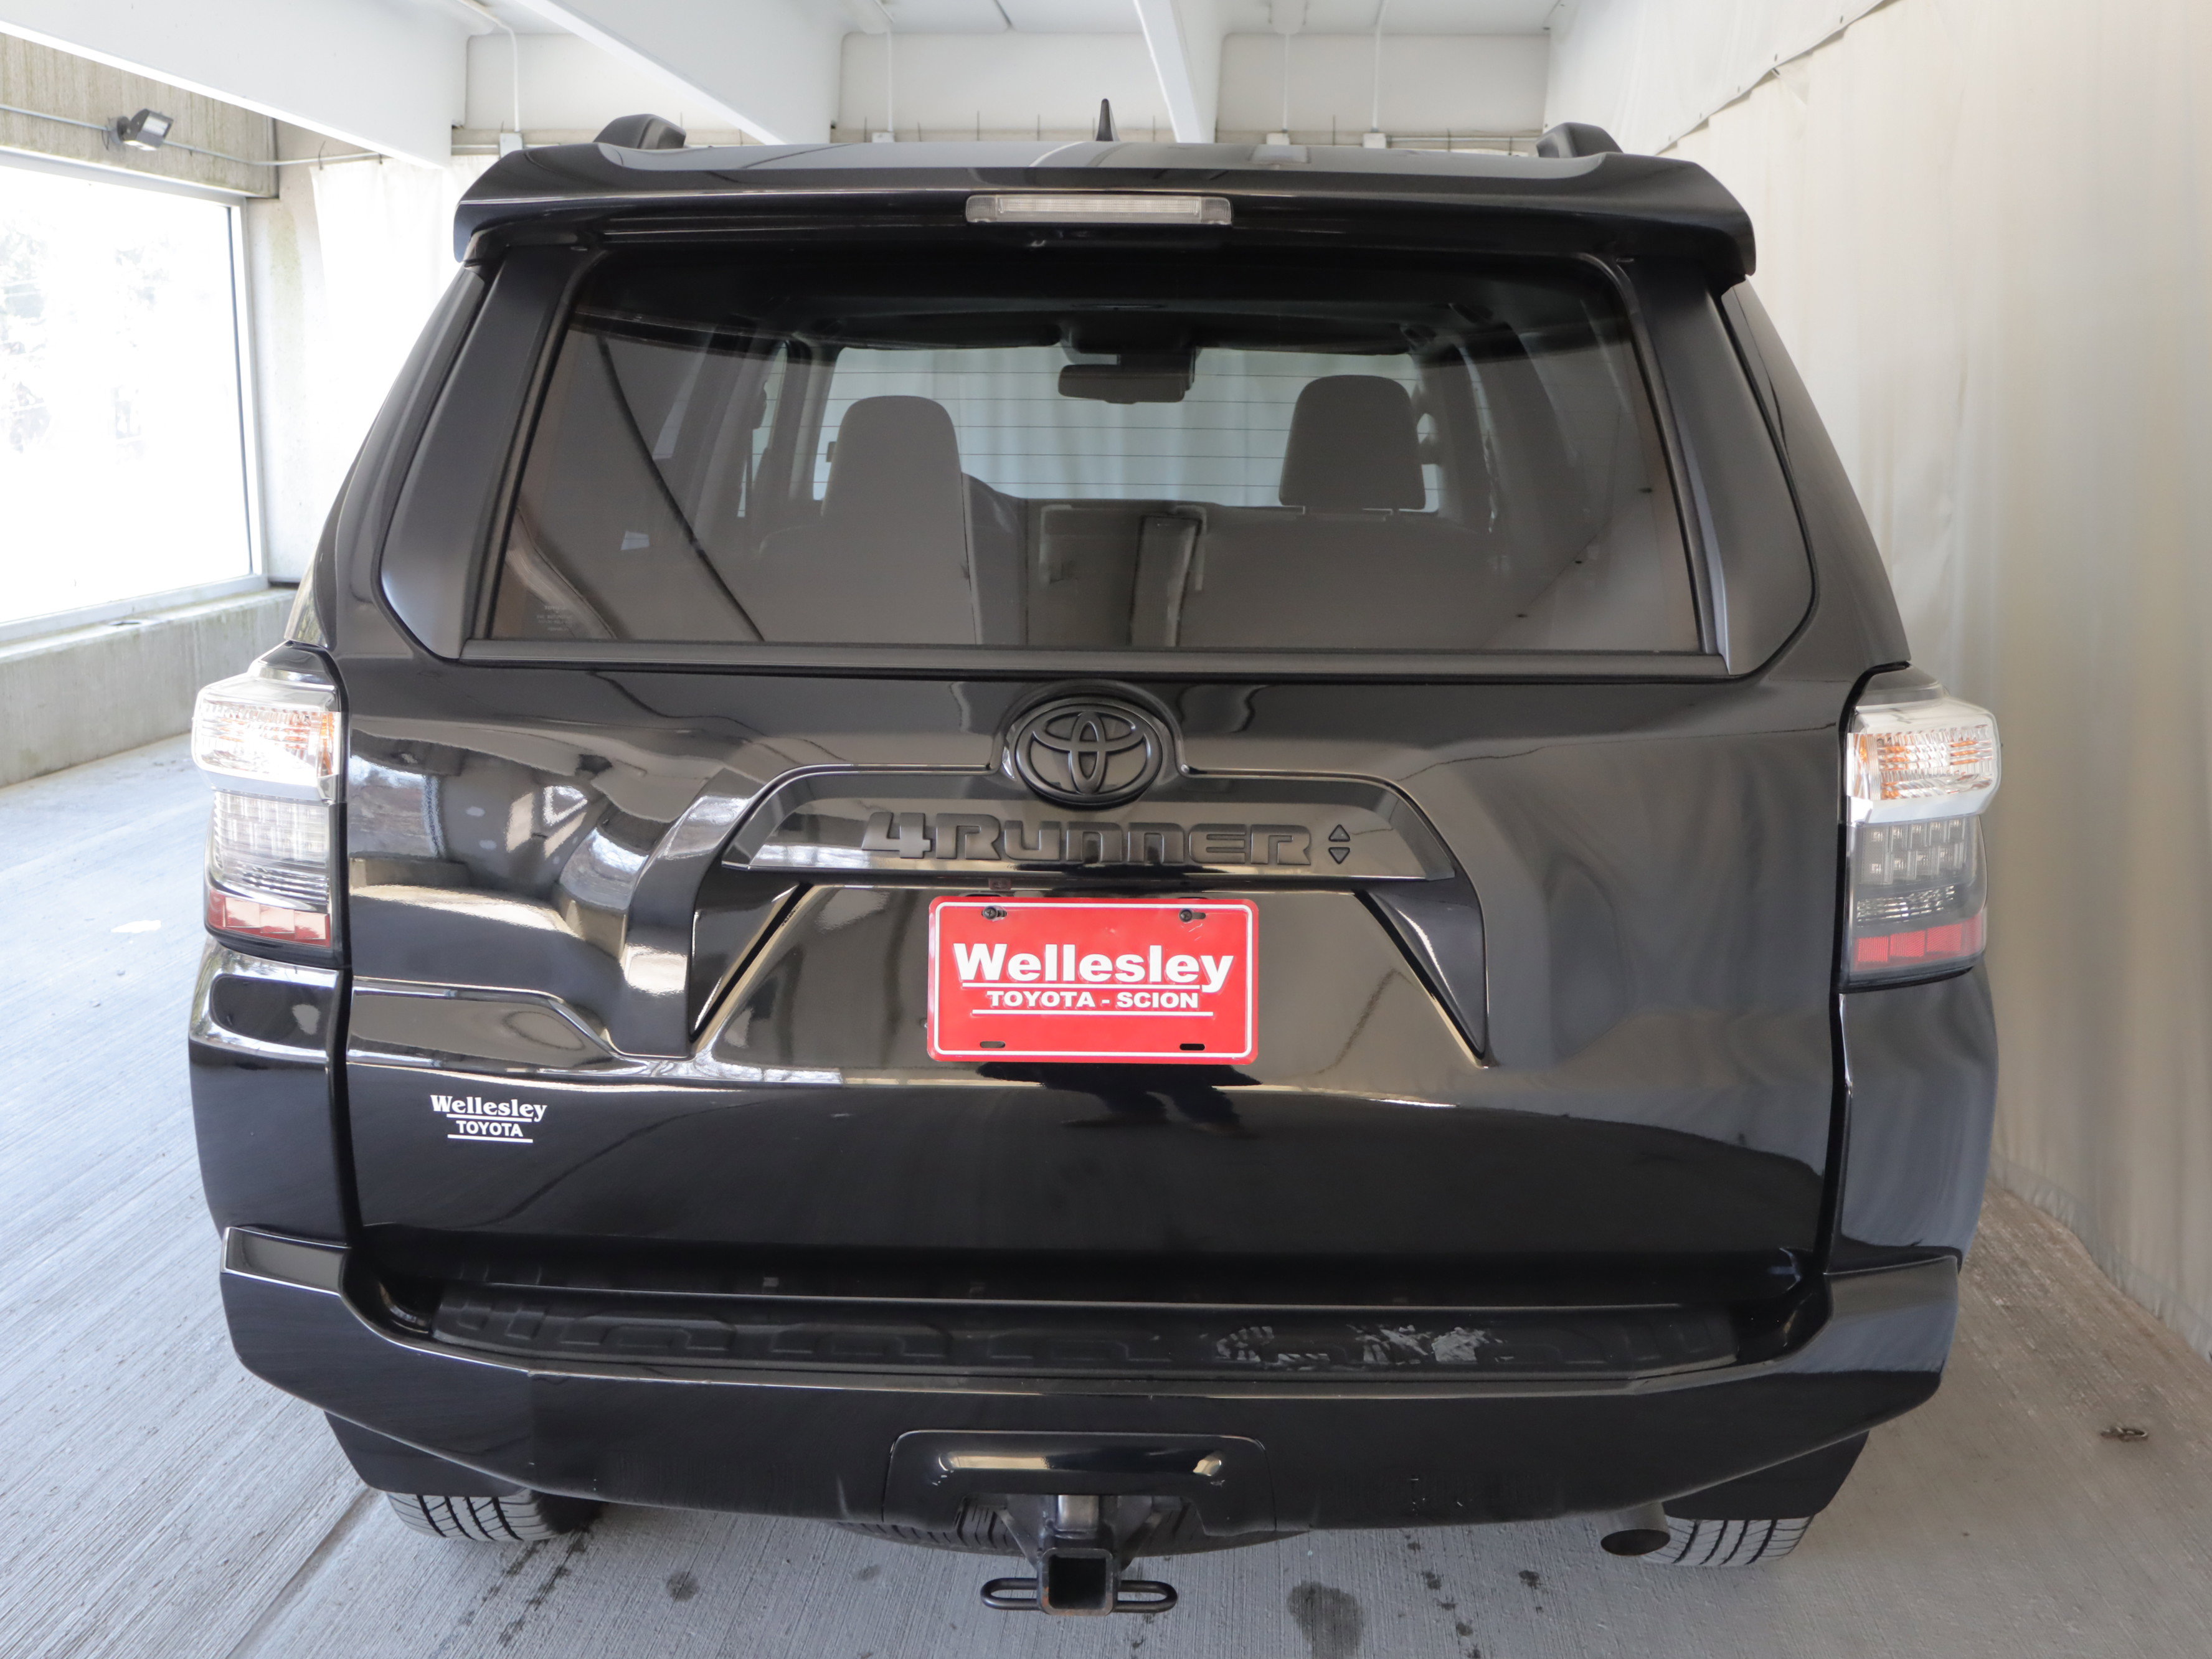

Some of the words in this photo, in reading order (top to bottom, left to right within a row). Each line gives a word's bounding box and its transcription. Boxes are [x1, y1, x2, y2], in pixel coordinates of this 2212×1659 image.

[861, 811, 1312, 866] 4RUNNER
[953, 943, 1234, 993] Wellesley
[986, 990, 1096, 1008] TOYOTA
[1116, 991, 1199, 1009] SCION
[430, 1094, 548, 1122] Wellesley
[455, 1120, 524, 1137] TOYOTA
